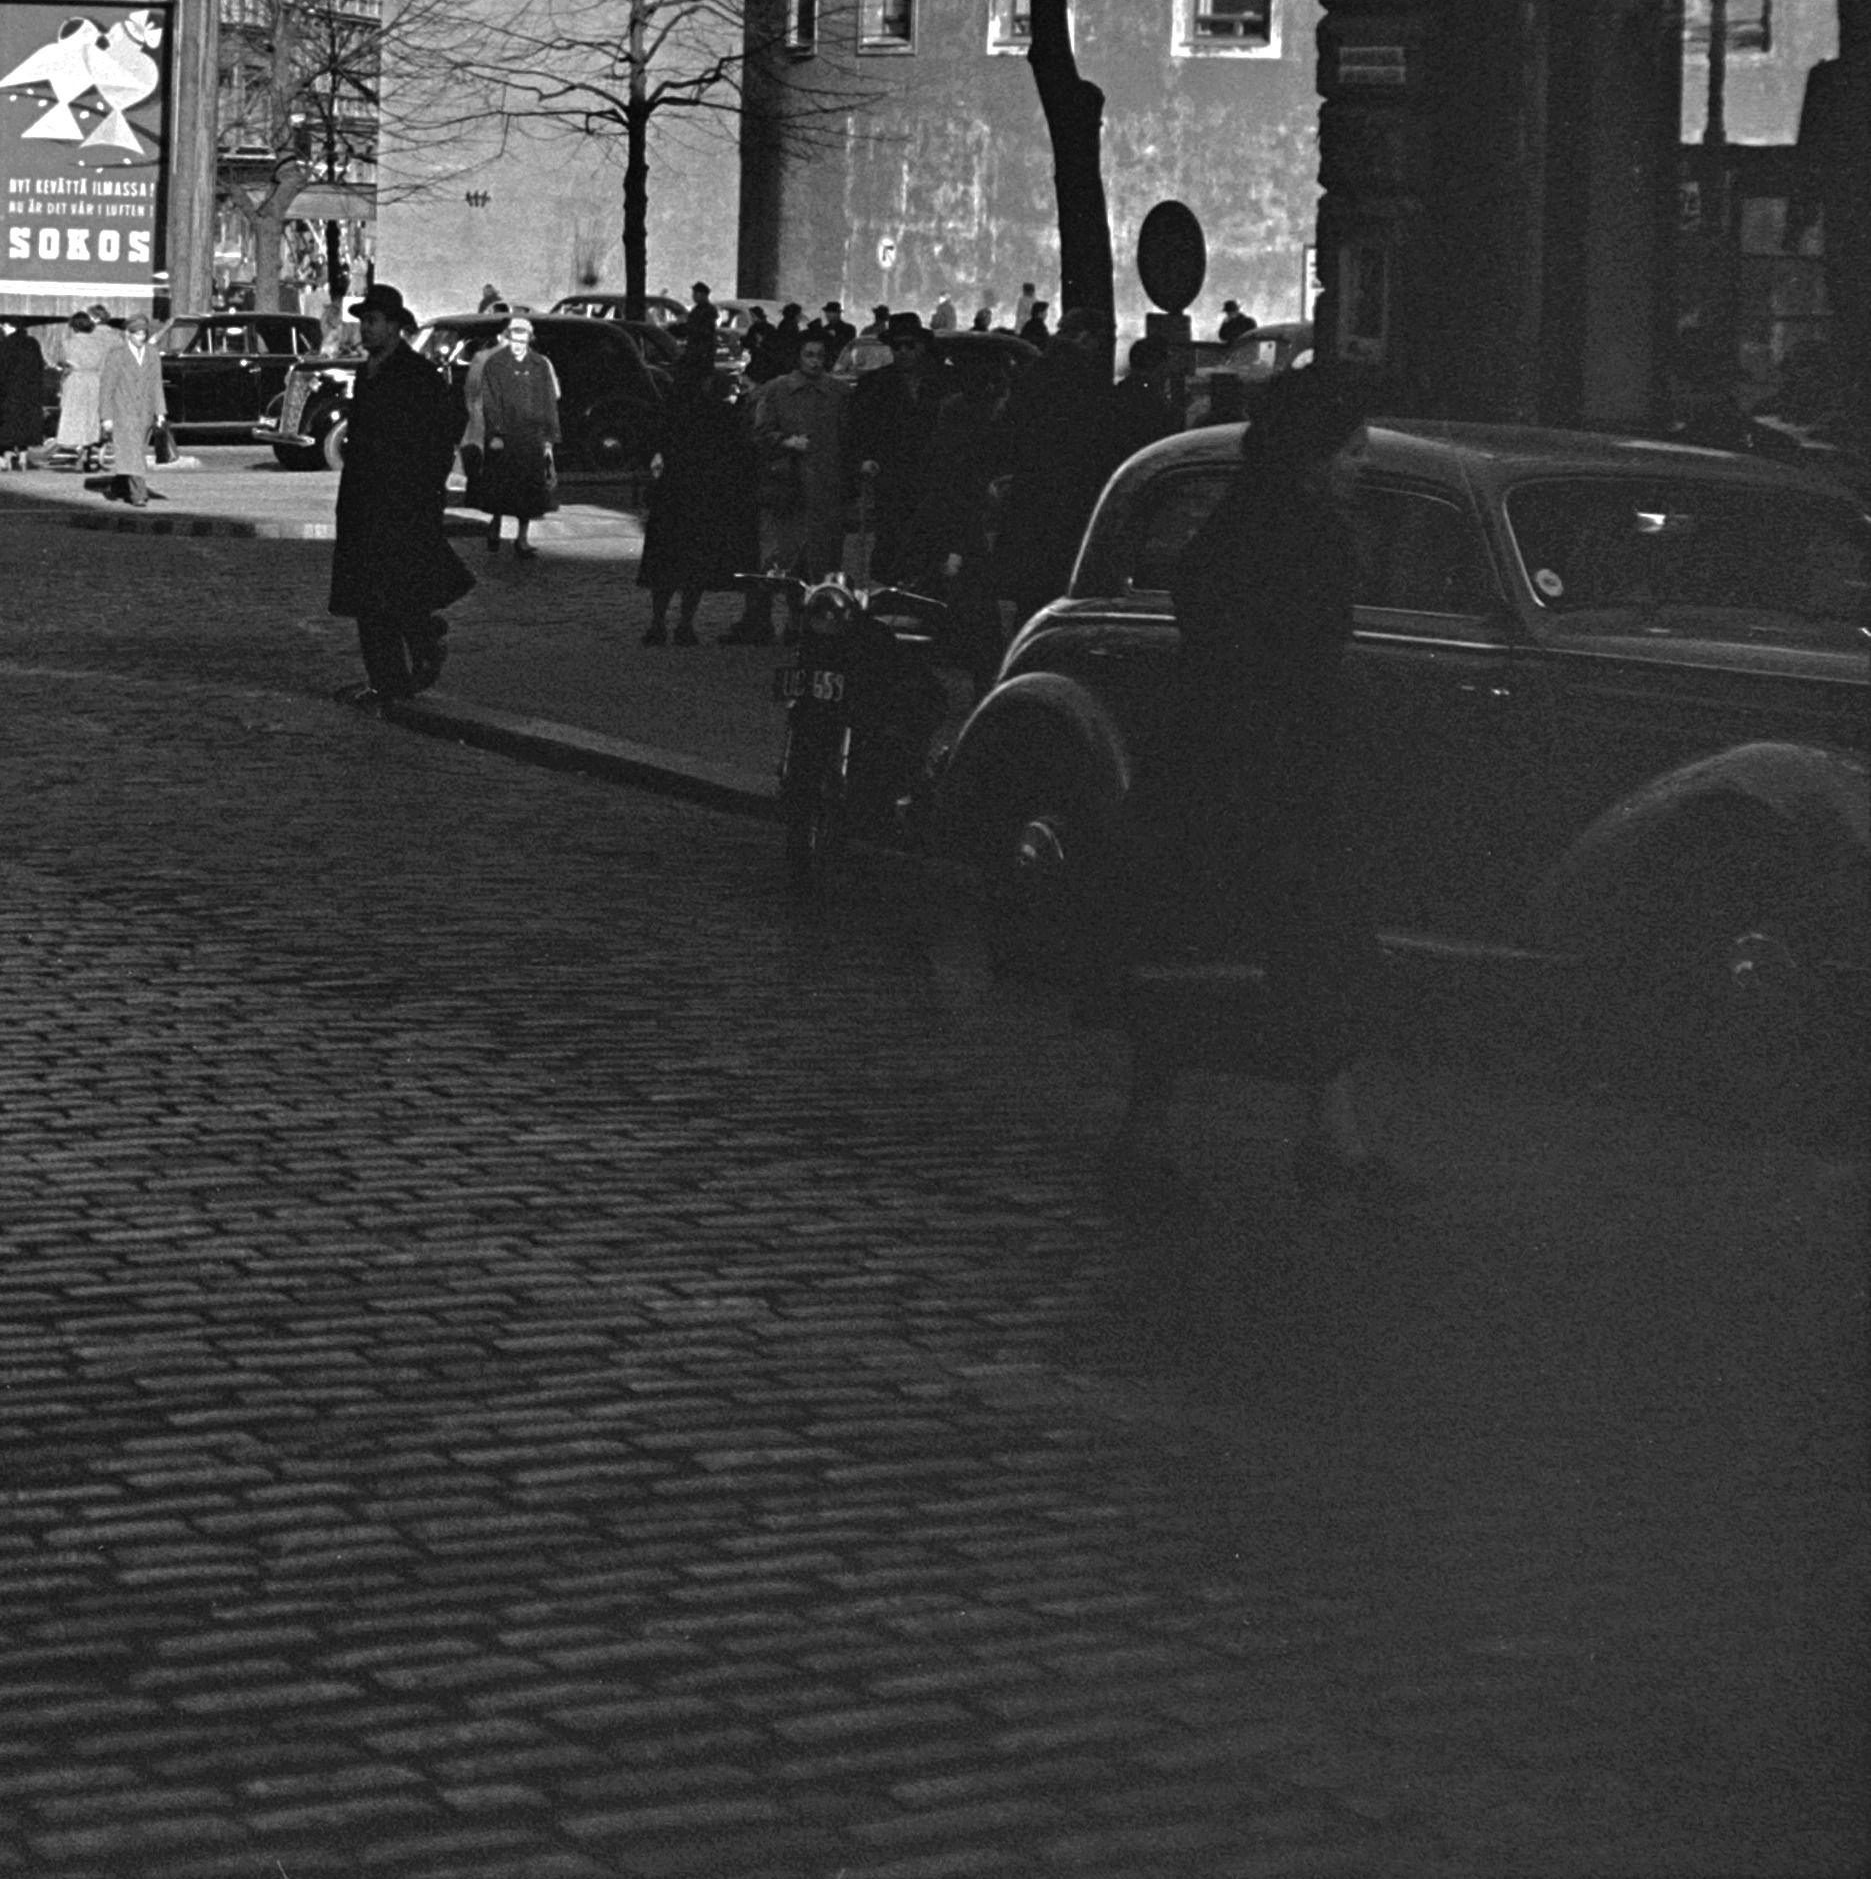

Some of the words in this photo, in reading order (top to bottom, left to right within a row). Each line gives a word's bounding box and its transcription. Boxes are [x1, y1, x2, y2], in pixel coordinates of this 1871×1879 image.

[9, 178, 31, 193] NYT
[36, 177, 87, 196] KEVÄTTÄ
[9, 201, 23, 214] NU
[28, 198, 42, 214] ÄR
[47, 202, 68, 216] DET
[9, 226, 150, 263] SOKOS
